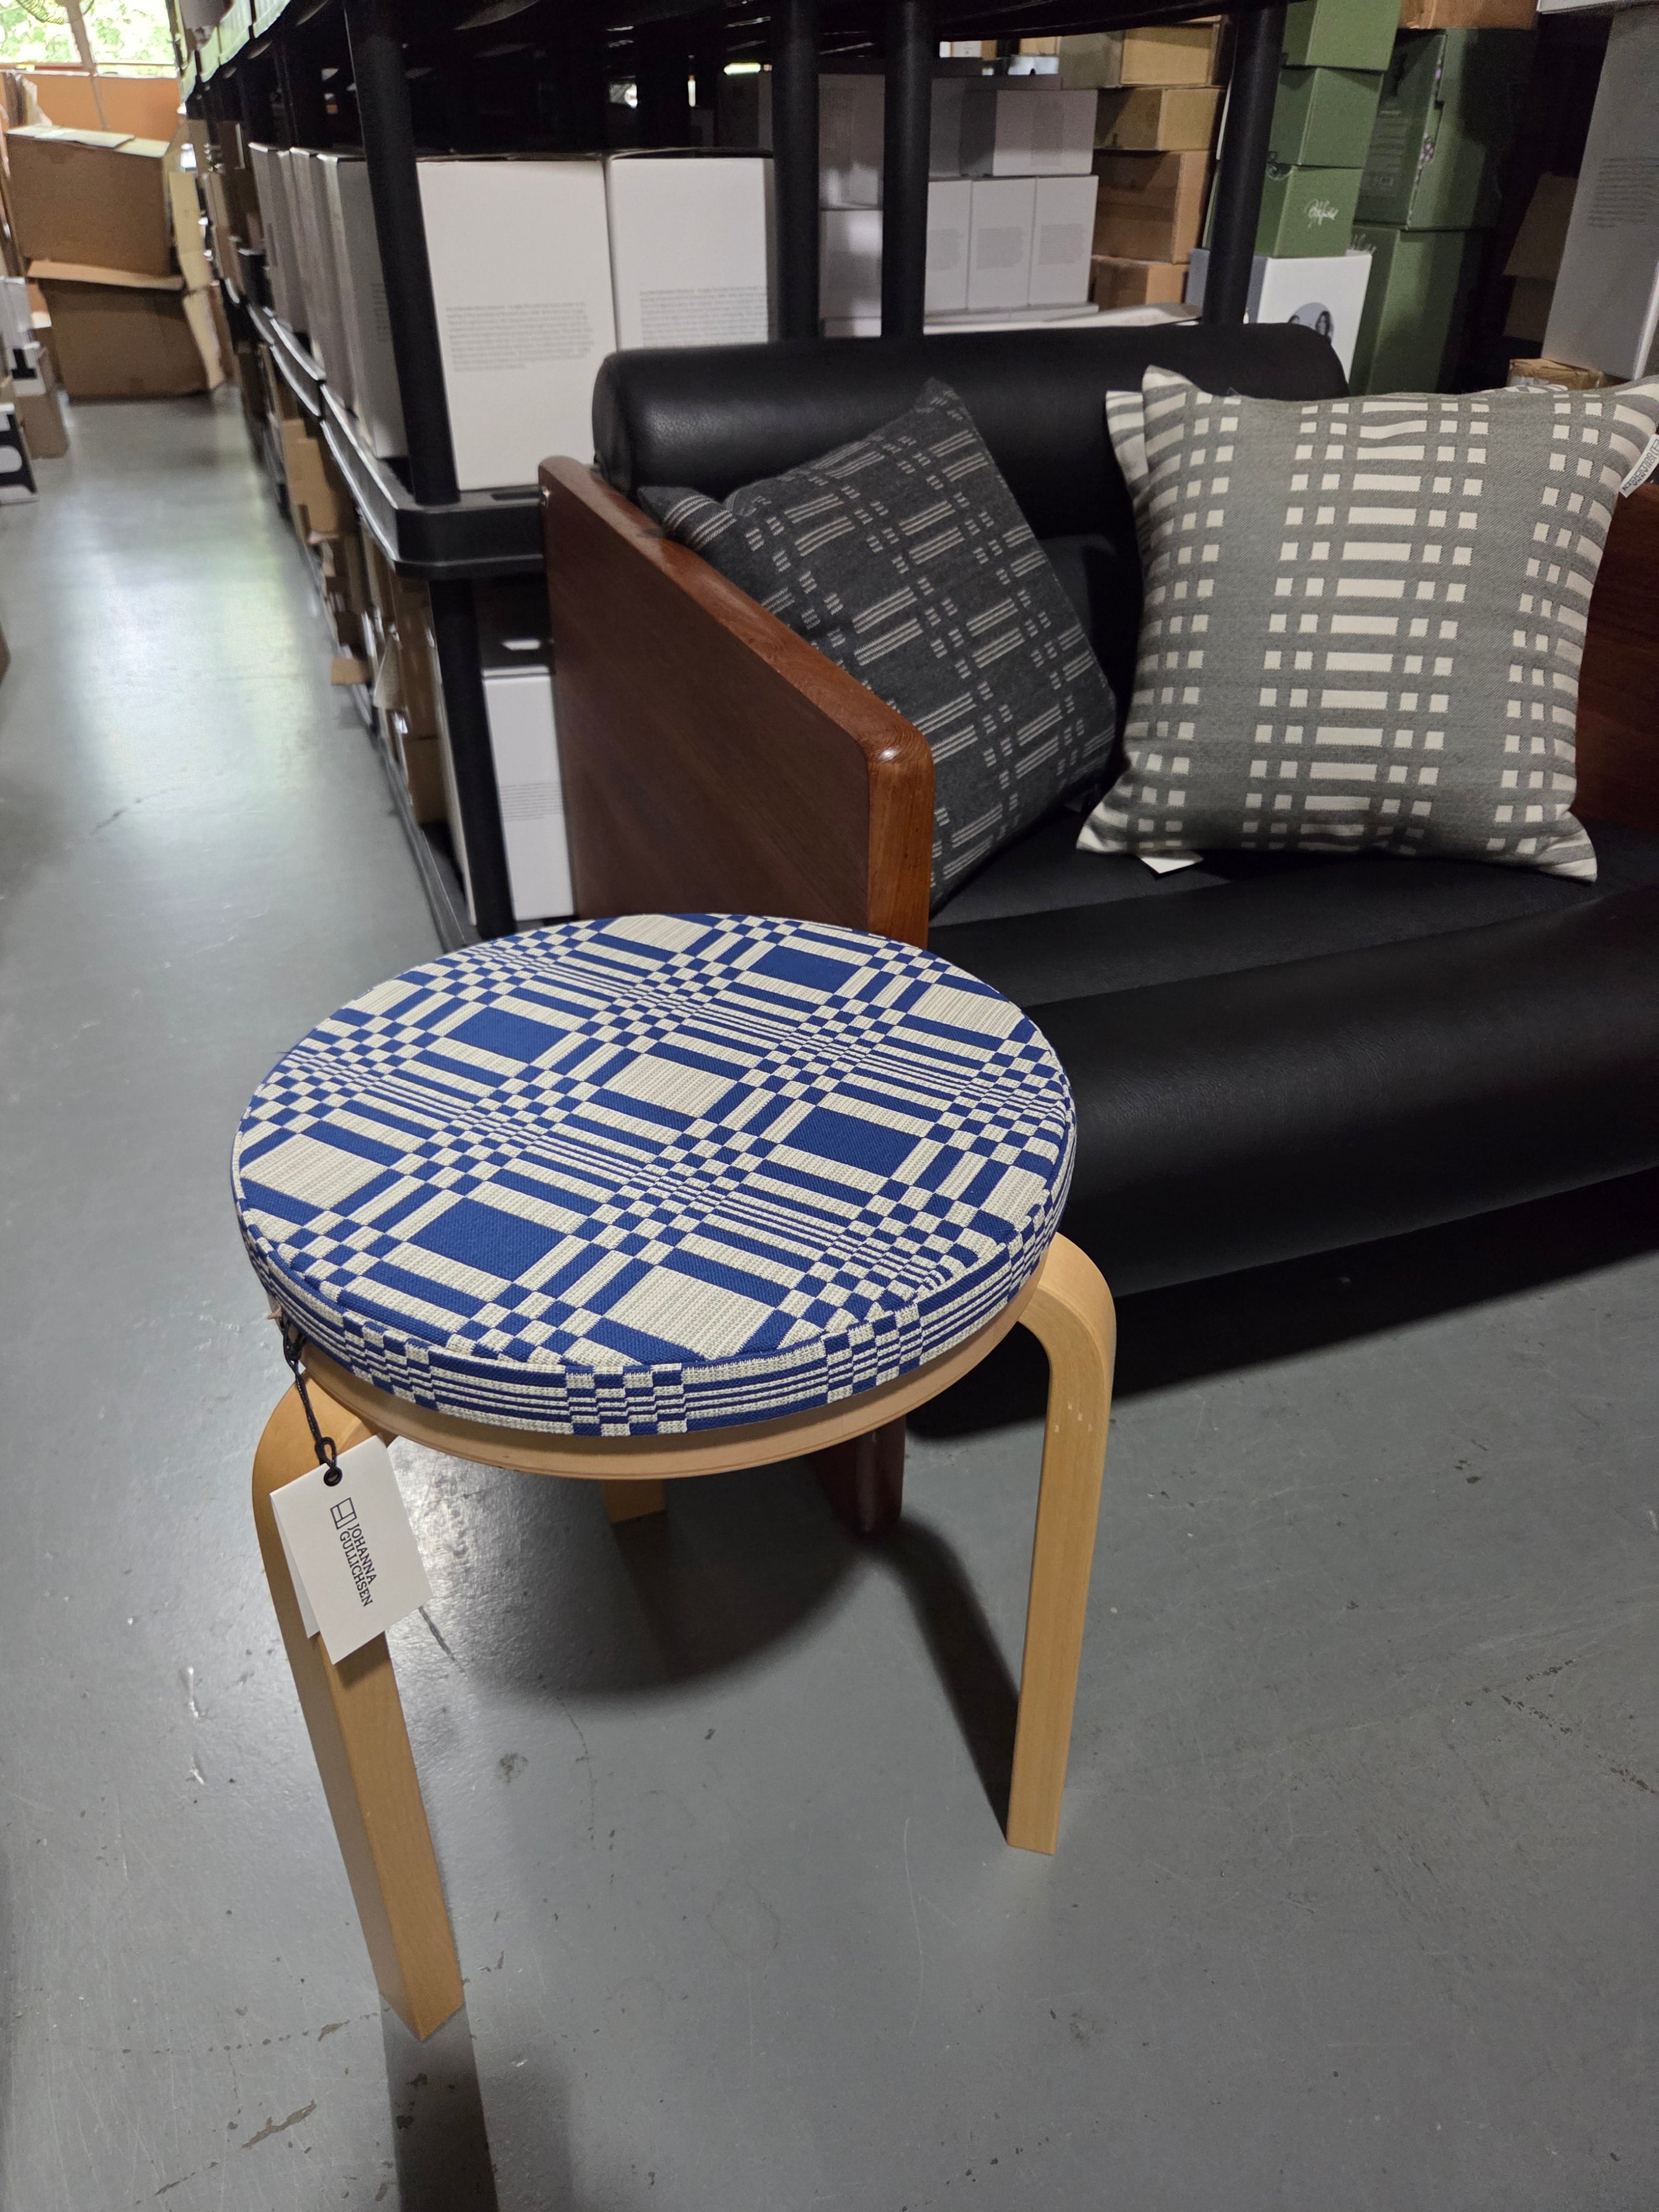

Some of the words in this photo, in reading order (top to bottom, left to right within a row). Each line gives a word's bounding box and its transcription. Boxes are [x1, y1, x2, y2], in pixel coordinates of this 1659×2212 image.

[1622, 452, 1652, 491] GULLICHSEN
[1633, 455, 1657, 486] JOHANNA
[340, 1531, 373, 1607] GULLICHSEN
[347, 1523, 377, 1585] JOHANNA
